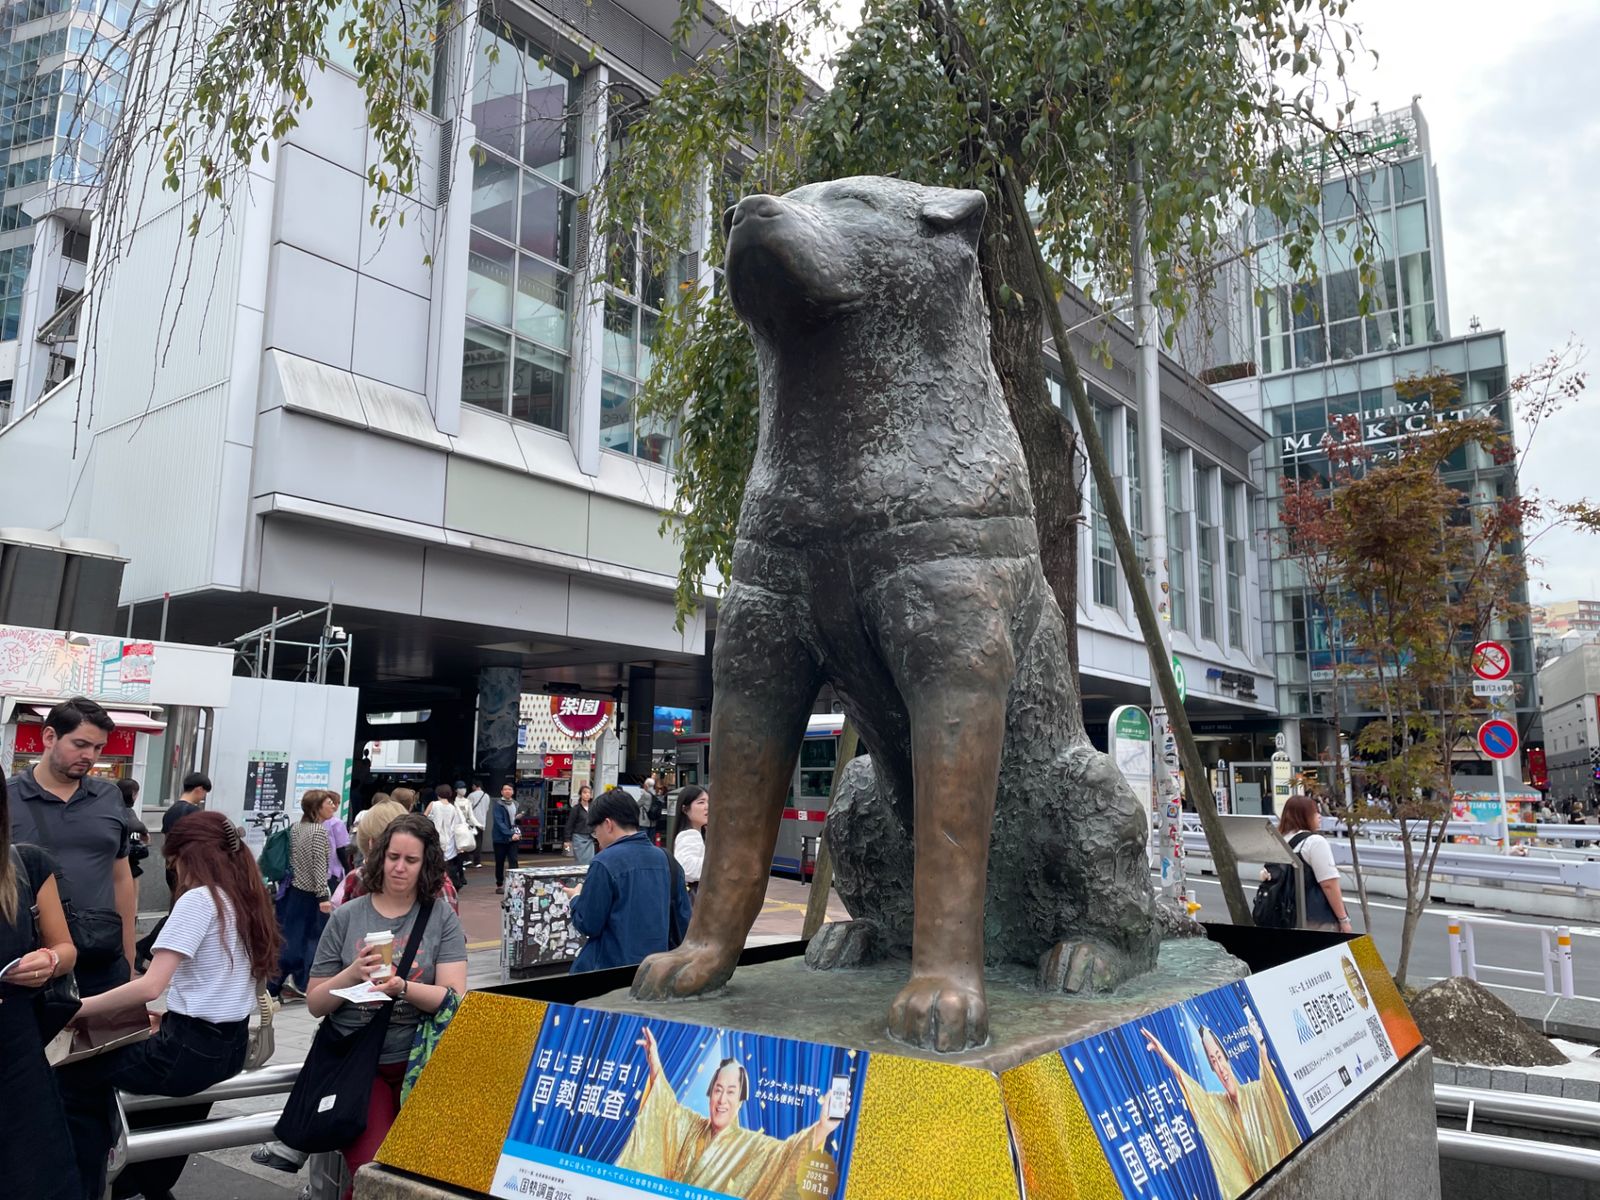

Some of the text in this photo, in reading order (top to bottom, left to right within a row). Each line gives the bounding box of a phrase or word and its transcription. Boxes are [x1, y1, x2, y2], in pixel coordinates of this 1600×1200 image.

[1405, 404, 1497, 432] CITY
[558, 697, 600, 716] 楽園
[552, 713, 575, 737] EXCITING
[532, 1074, 627, 1120] 国勢調査
[757, 1077, 821, 1097] インターネット回答で
[1119, 1114, 1197, 1187] 国勢調査
[802, 1179, 829, 1195] 10月1日
[806, 1170, 829, 1183] 2025年
